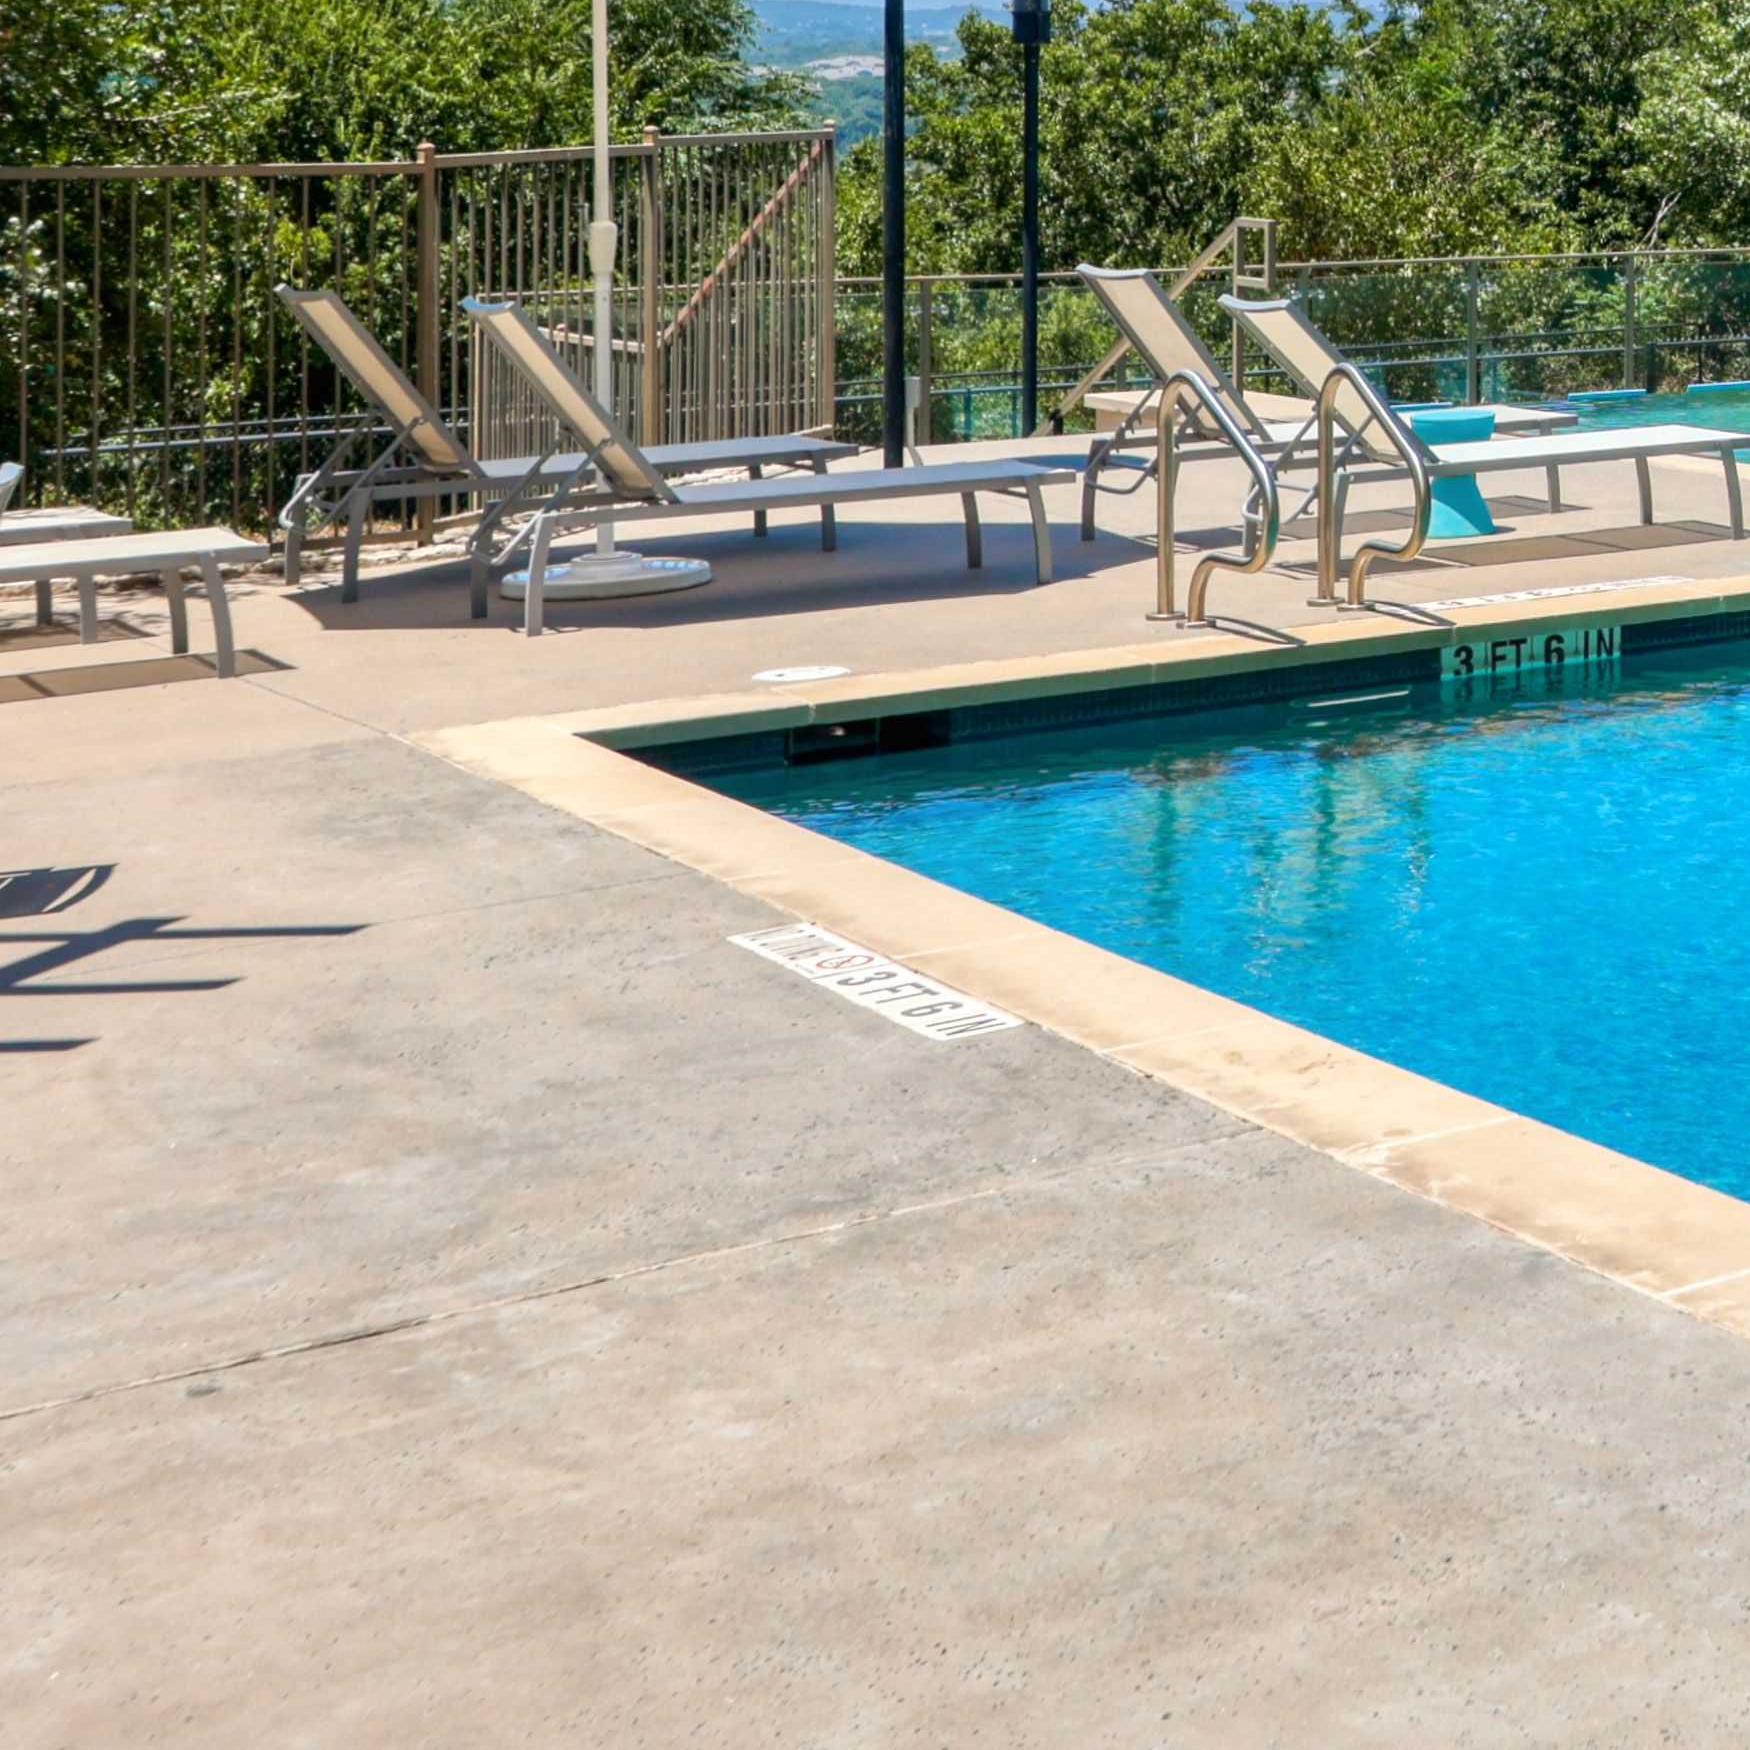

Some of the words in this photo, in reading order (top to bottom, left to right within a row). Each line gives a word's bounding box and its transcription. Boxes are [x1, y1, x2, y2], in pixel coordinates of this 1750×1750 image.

[1453, 644, 1474, 676] 3
[1491, 637, 1527, 672] FT
[1543, 633, 1565, 665] 6
[1583, 626, 1614, 660] IN
[836, 970, 898, 986] 3
[858, 982, 940, 1004] FT
[900, 1000, 964, 1017] 6
[925, 1013, 1007, 1036] IN
